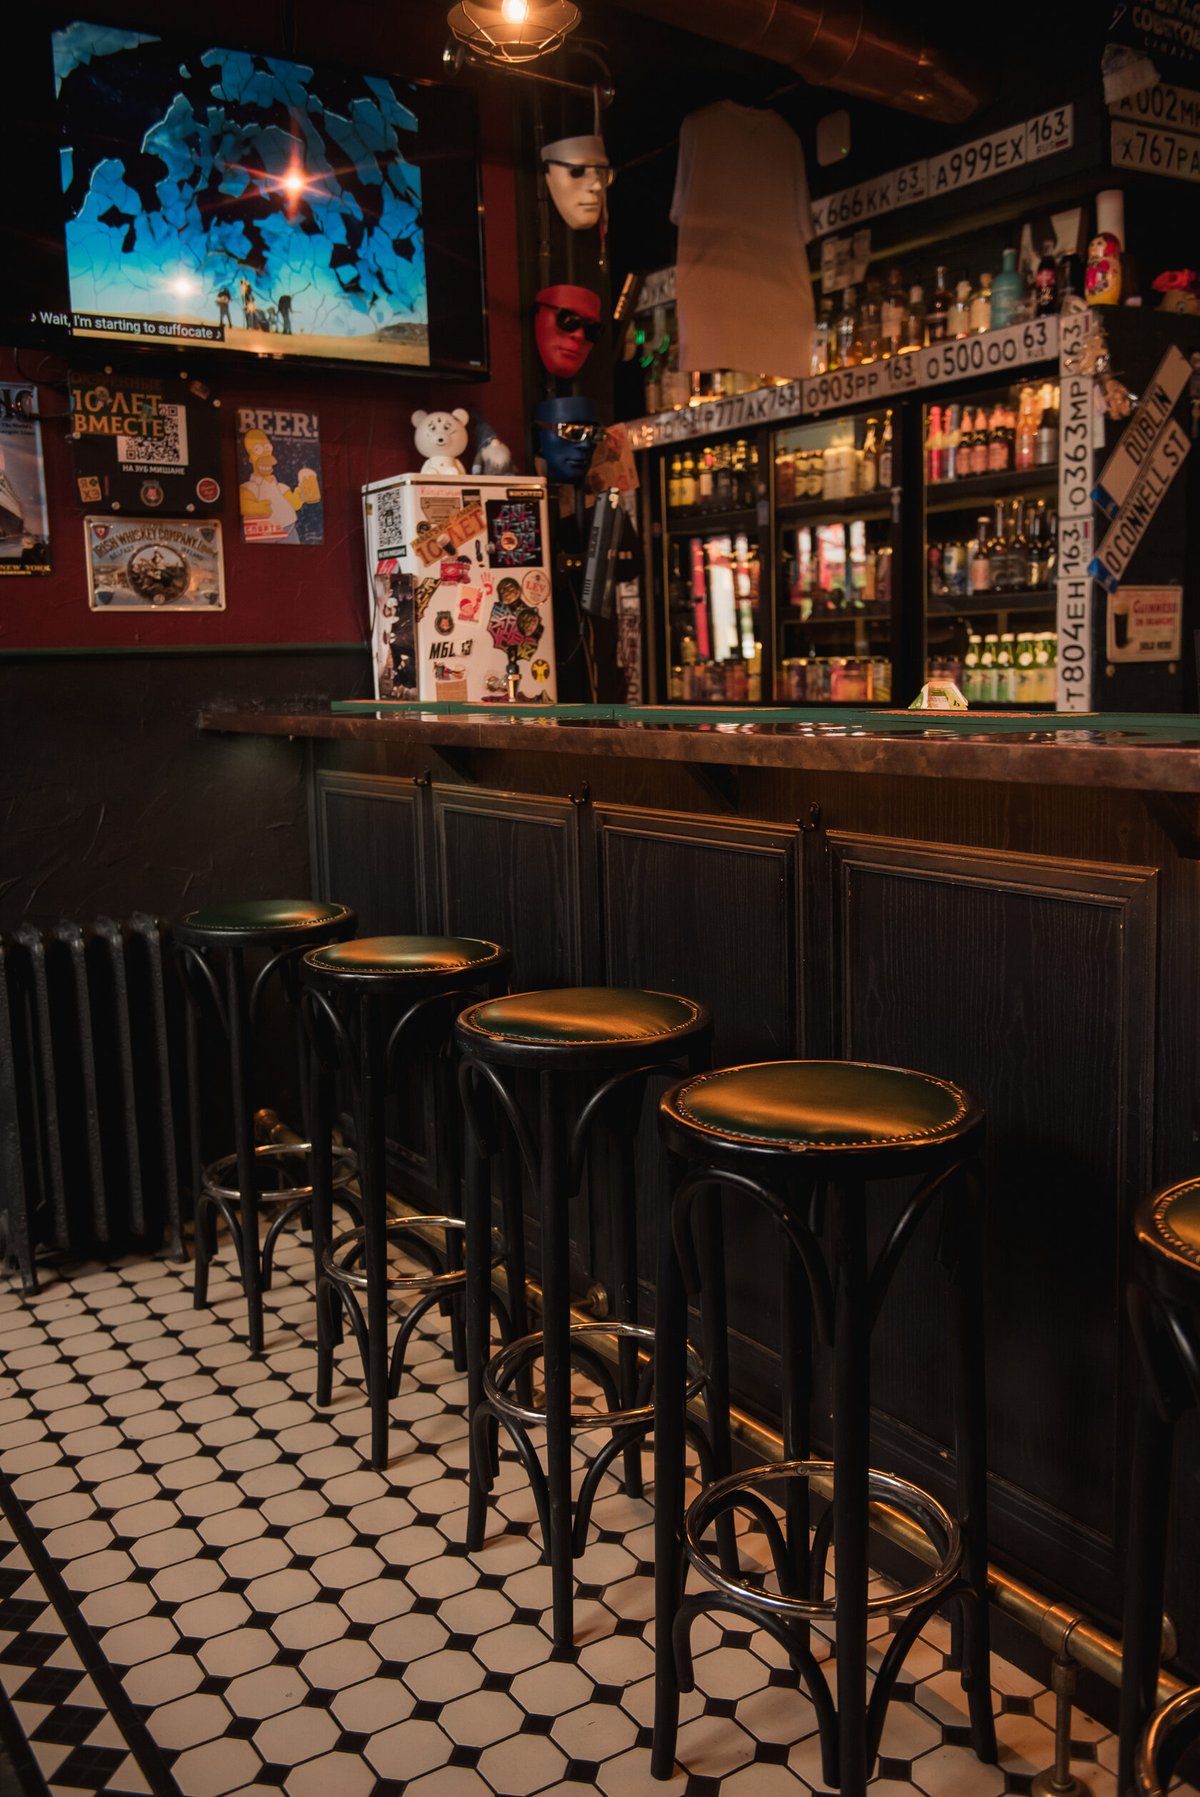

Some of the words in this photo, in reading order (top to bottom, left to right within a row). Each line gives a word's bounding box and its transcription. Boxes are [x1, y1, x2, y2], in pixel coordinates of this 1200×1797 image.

[1029, 109, 1066, 145] 163
[897, 165, 920, 193] 63
[39, 311, 71, 328] Wait,
[73, 314, 92, 329] I'm
[95, 317, 141, 335] starting
[143, 322, 156, 334] to
[158, 323, 213, 339] suffocate
[1023, 322, 1048, 349] 63
[885, 356, 913, 383] 163
[73, 413, 165, 437] ВМЕСТЕ
[238, 408, 319, 438] BEER!
[1124, 385, 1173, 466] DUBLIN
[1163, 430, 1186, 467] ST
[1063, 528, 1081, 576] 163
